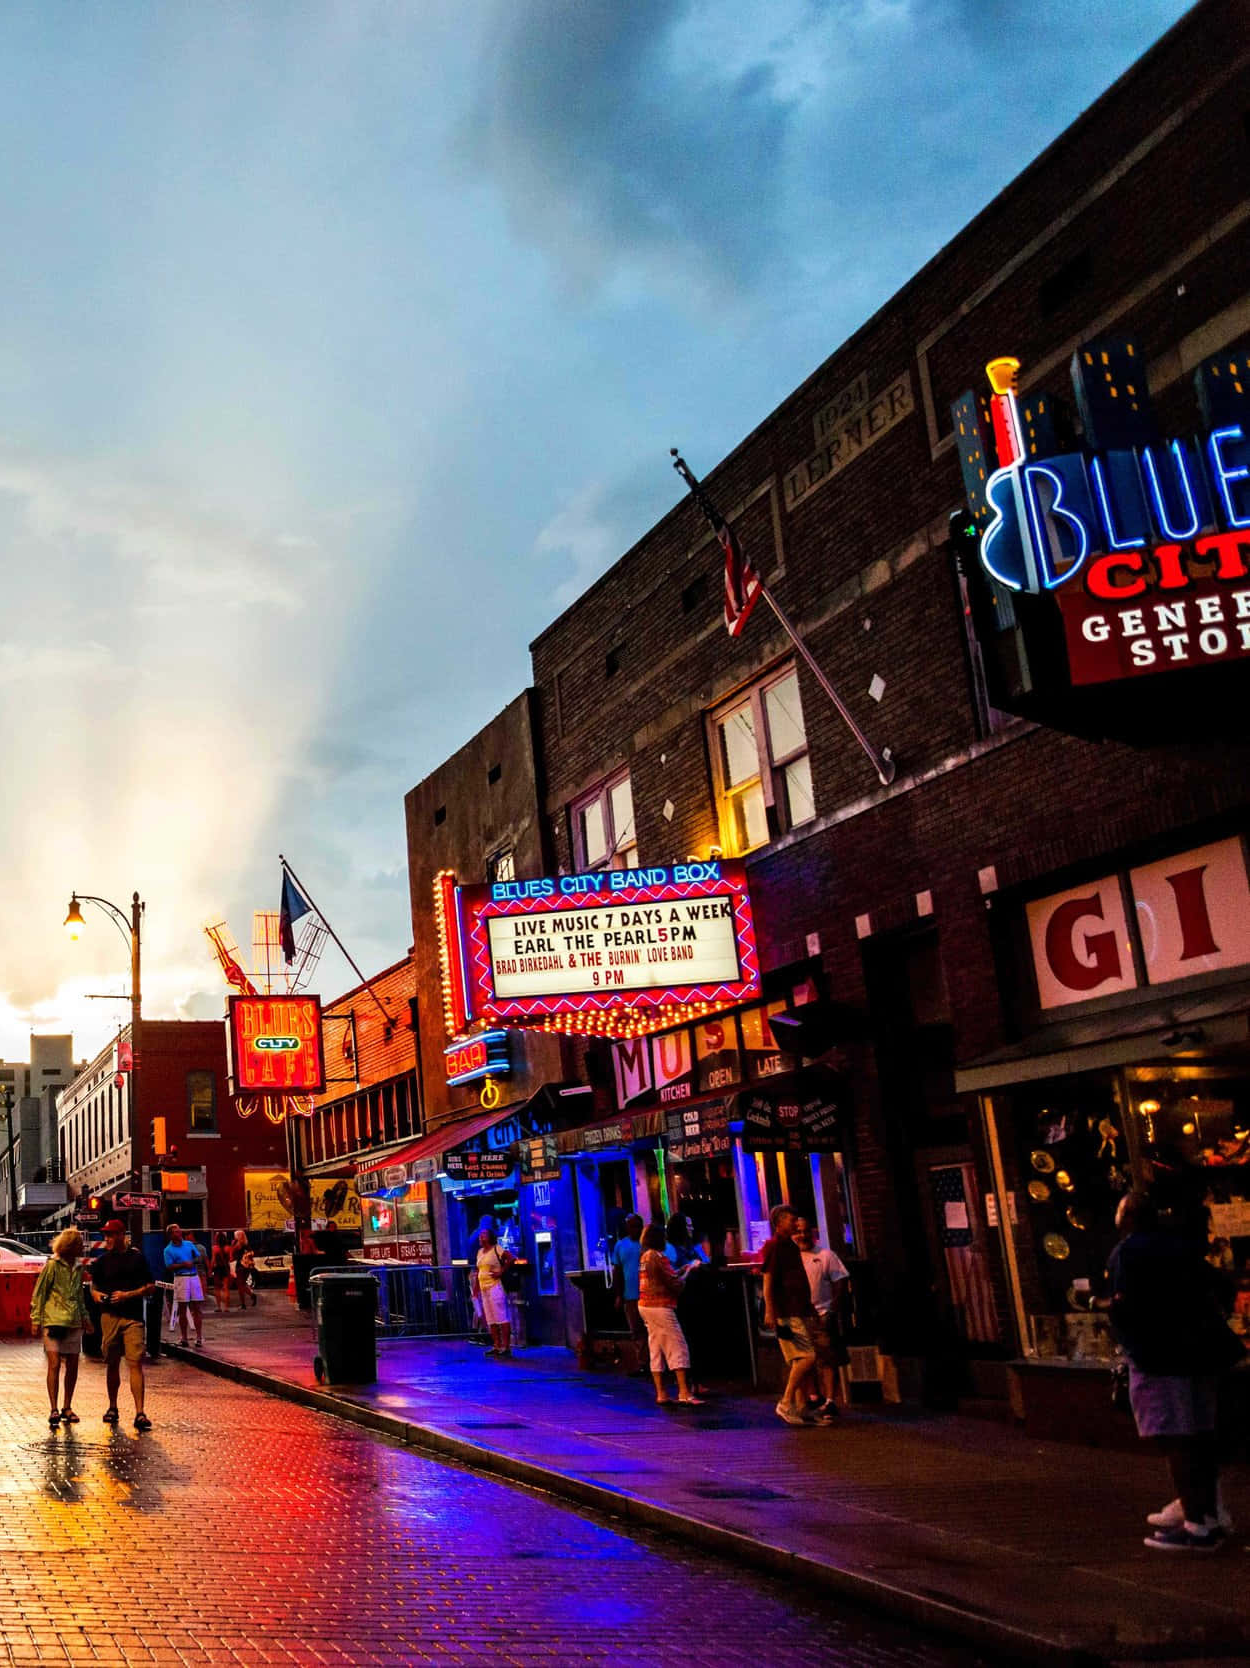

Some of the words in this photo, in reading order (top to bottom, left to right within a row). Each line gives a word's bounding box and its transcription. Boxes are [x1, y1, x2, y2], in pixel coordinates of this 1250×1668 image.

[493, 879, 554, 900] BLUES
[560, 875, 603, 893] CITY
[611, 868, 667, 890] BAND
[674, 862, 720, 883] BOX
[514, 919, 547, 937] LIVE
[552, 914, 599, 934] MUSIC
[605, 913, 614, 928] 7
[621, 910, 662, 927] DAYS
[669, 908, 680, 922] A
[686, 901, 731, 921] WEEK
[514, 936, 555, 955] EARL
[564, 933, 595, 951] THE
[496, 958, 517, 976] BRAD
[519, 954, 564, 974] BIRKEDAHL
[568, 953, 577, 968] &
[579, 950, 603, 968] THE
[647, 946, 668, 963] LOVE
[671, 945, 694, 961] BAND
[592, 971, 600, 986] 9
[605, 969, 625, 986] PM
[242, 1002, 315, 1036] BLUES
[257, 1038, 296, 1048] CITY
[616, 998, 786, 1101] MUSI
[446, 1041, 487, 1076] BAR
[757, 1055, 782, 1077] LATE
[708, 1066, 733, 1087] OPEN
[659, 1082, 692, 1104] KITCHEN
[778, 1105, 799, 1119] STOP
